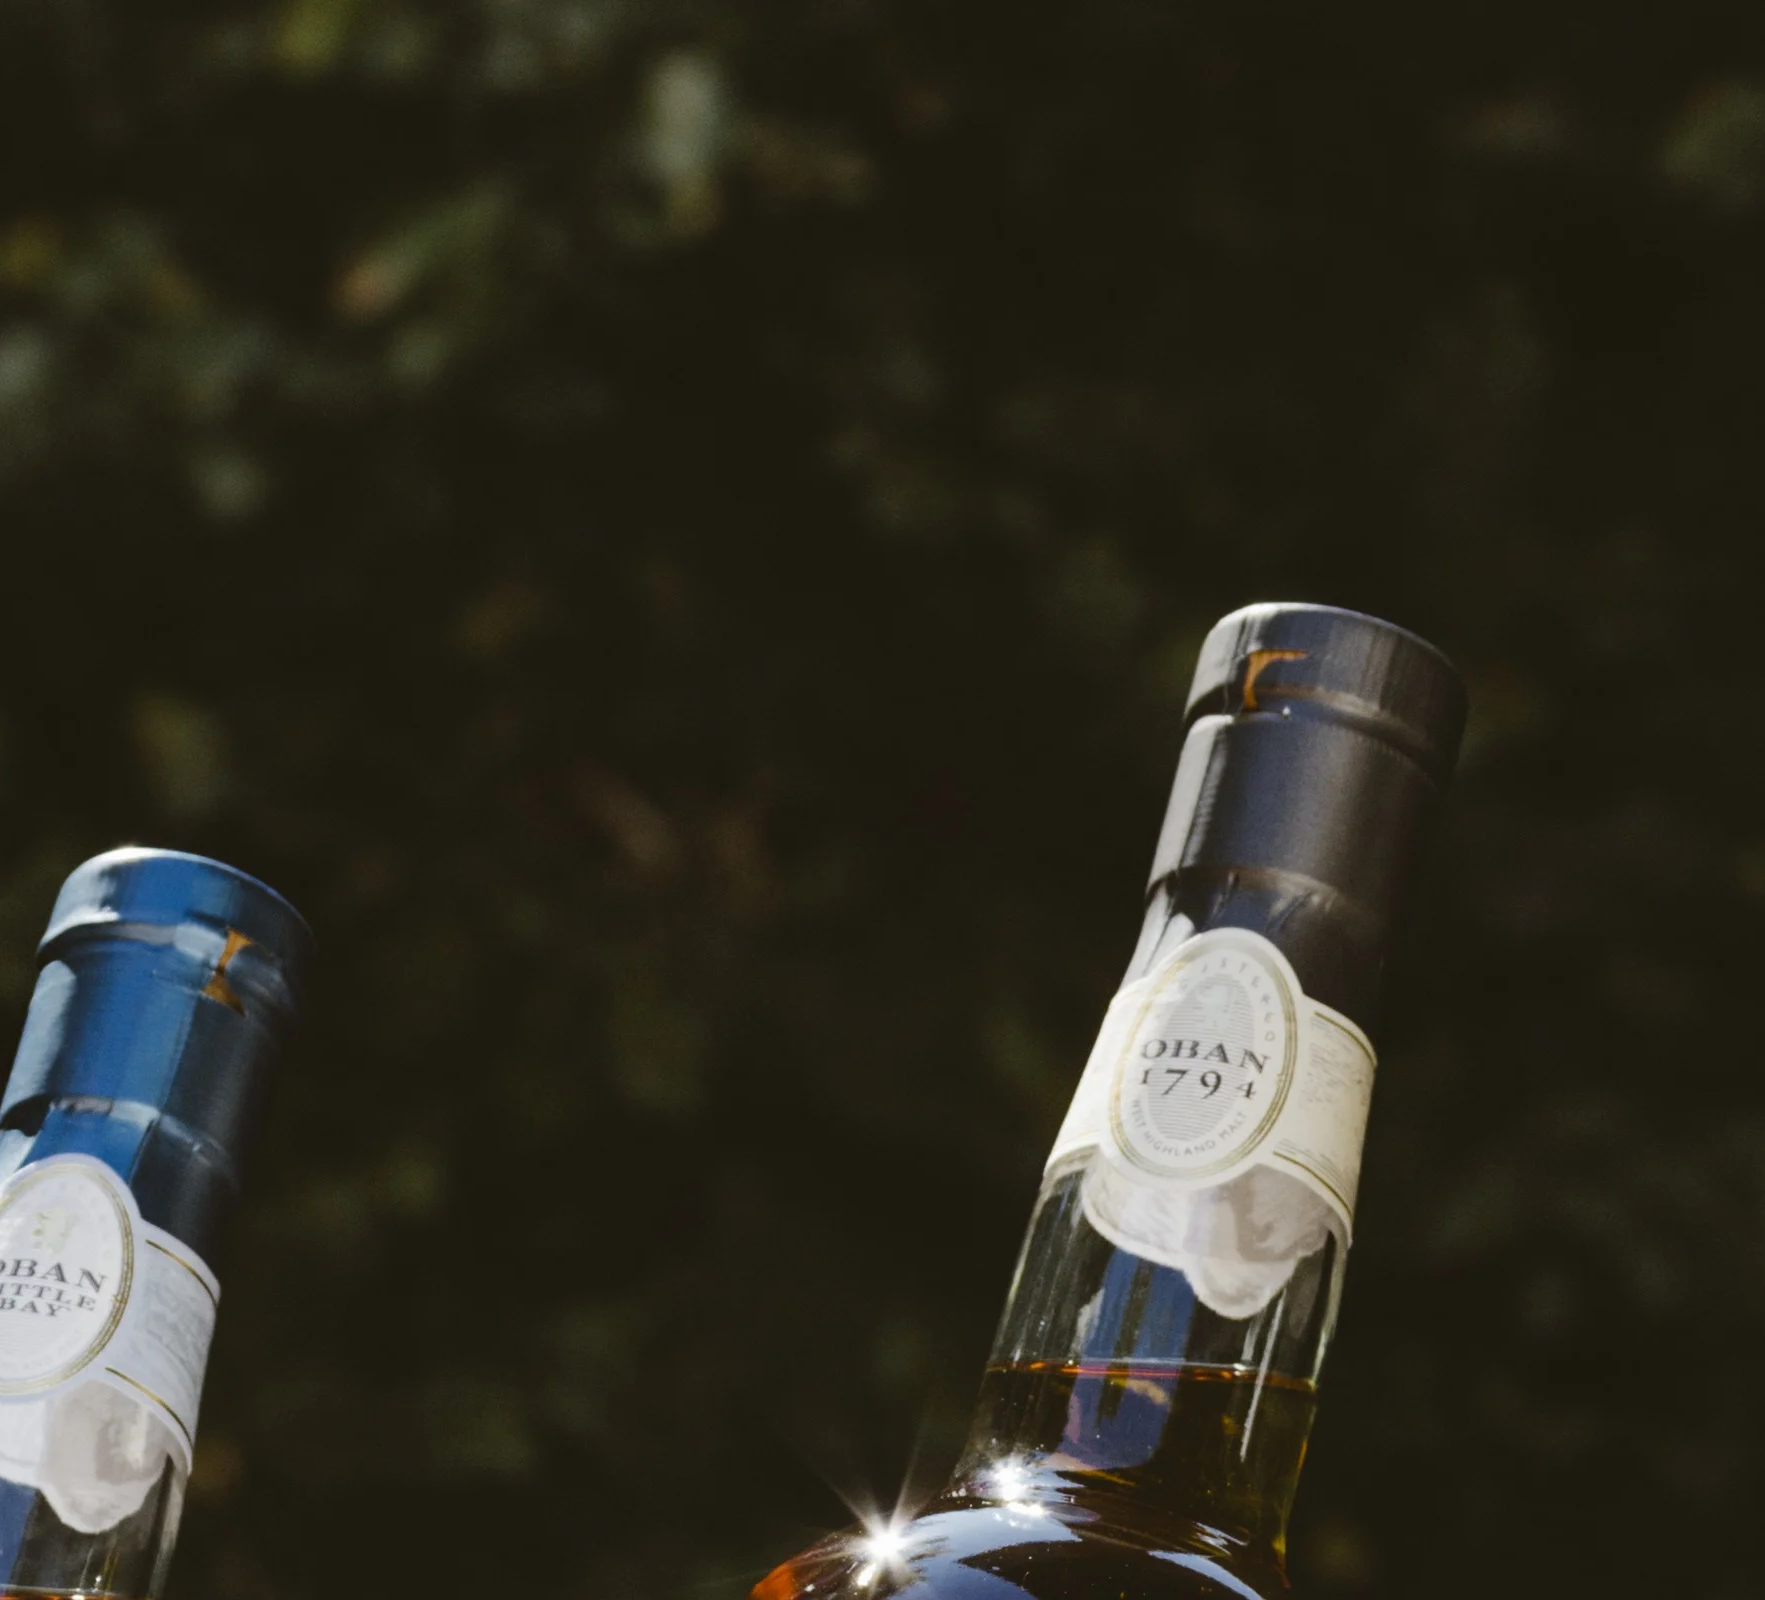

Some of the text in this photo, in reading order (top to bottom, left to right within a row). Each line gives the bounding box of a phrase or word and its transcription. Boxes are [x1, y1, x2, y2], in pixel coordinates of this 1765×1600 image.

[1141, 1039, 1271, 1074] OBAN
[1141, 1068, 1257, 1099] 1794
[1144, 1131, 1216, 1157] HIGHLAND
[1218, 1111, 1247, 1140] MALT
